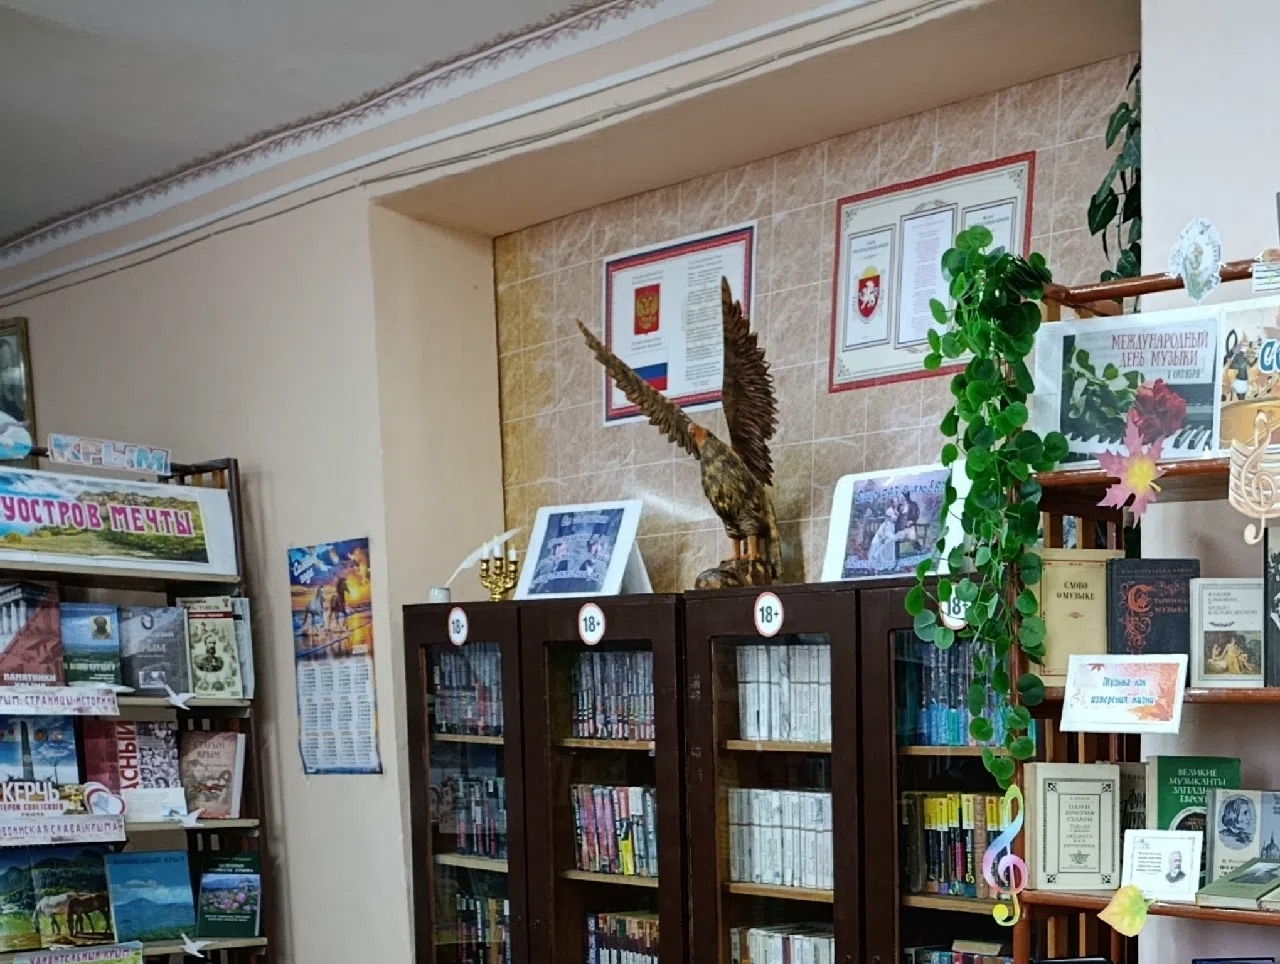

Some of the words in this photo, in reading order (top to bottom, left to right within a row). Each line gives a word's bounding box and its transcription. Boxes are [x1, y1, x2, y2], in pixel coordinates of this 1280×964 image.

[1111, 330, 1208, 350] МЕЖДУНАРОДНЫЙ
[1119, 354, 1145, 368] ДЕНЬ
[1150, 350, 1198, 366] МУЗЫКИ
[110, 504, 194, 538] МЕЧТЫ
[1064, 581, 1088, 589] СЛОВО
[1063, 592, 1095, 600] МУЗЫКЕ
[759, 606, 779, 624] 18+
[452, 619, 466, 635] 18+
[582, 615, 601, 634] 18+
[1134, 678, 1146, 686] как
[1169, 777, 1226, 786] МУЗЫКАНТЫ
[1178, 769, 1217, 777] ВЕЛИКИЕ
[2, 782, 60, 802] КЕРЧЬ
